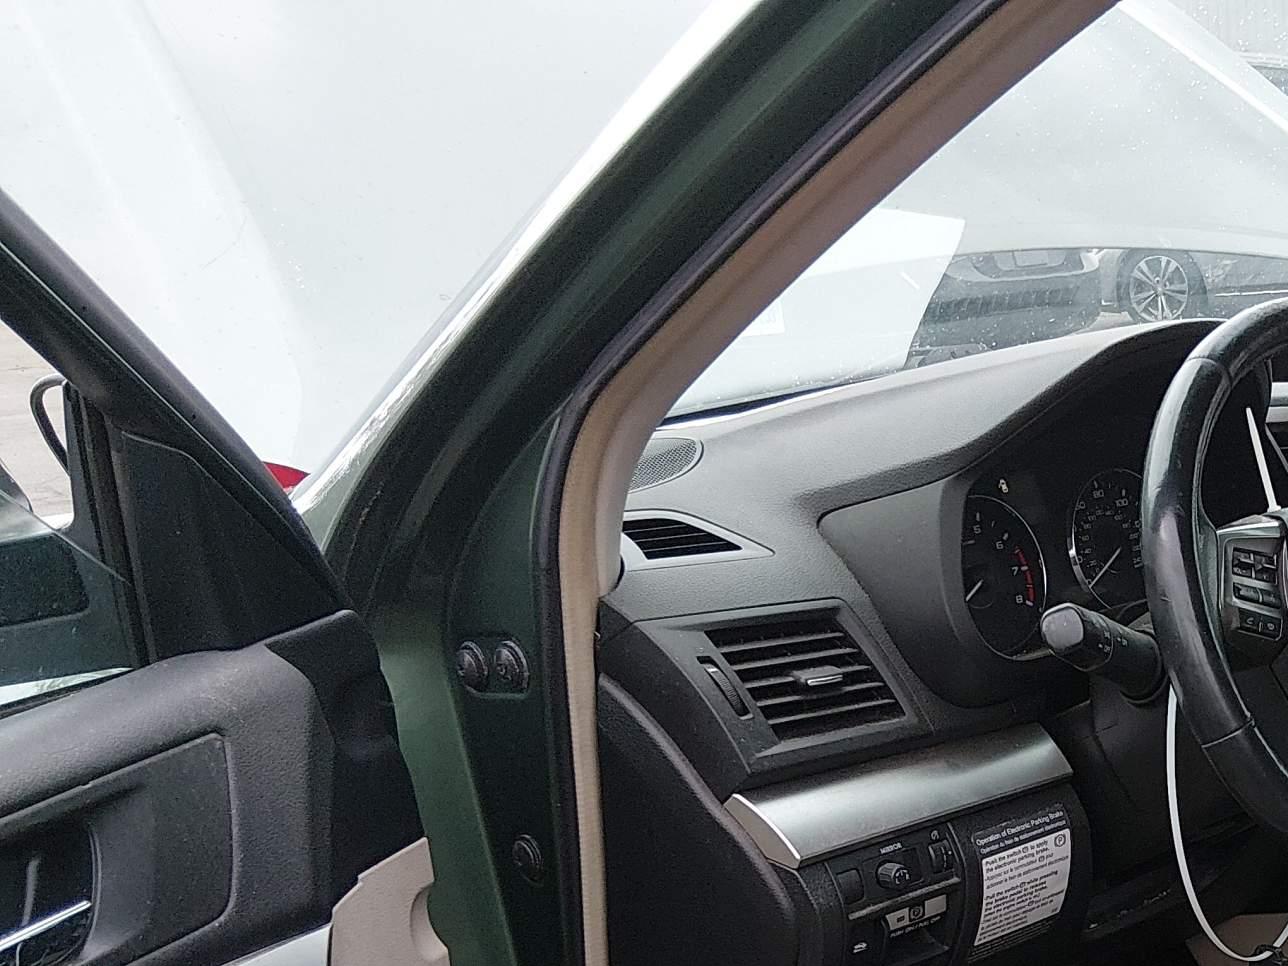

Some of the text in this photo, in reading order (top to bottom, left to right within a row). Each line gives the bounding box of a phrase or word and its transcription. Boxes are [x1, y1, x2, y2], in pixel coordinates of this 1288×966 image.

[973, 524, 982, 534] 5
[995, 540, 1004, 550] 6
[1011, 566, 1019, 576] 7
[1015, 594, 1023, 604] 8
[976, 833, 1001, 846] Operation
[1031, 816, 1050, 826] Parking
